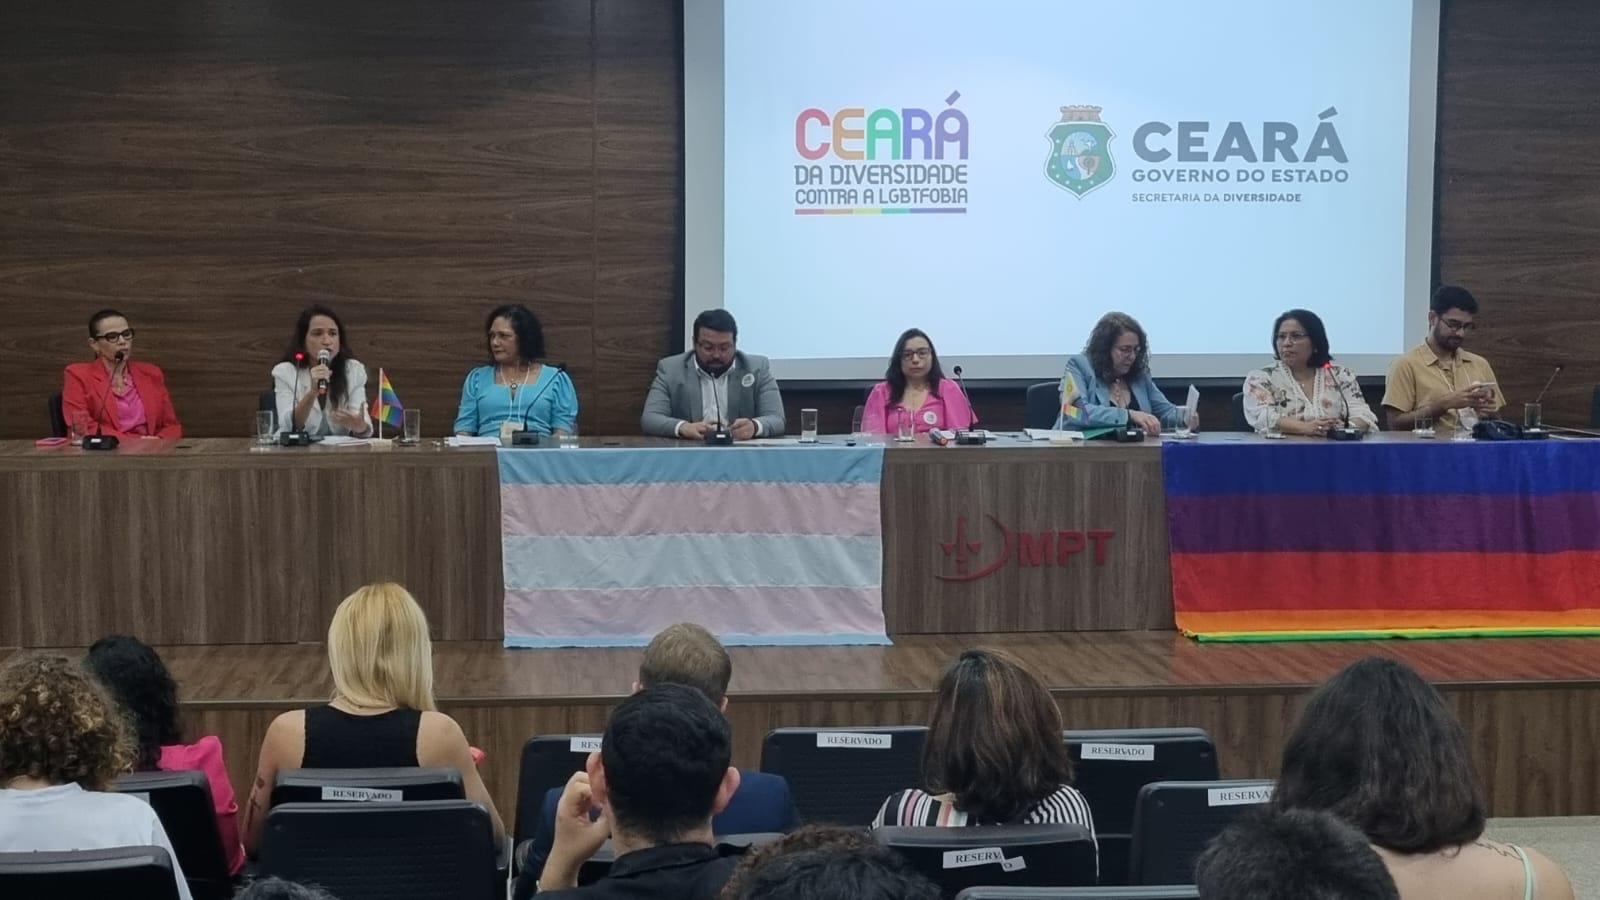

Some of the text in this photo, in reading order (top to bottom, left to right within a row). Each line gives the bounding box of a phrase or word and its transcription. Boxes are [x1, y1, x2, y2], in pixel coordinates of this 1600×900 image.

[795, 90, 969, 160] CEARÁ
[1132, 106, 1349, 163] CEARÁ
[794, 164, 968, 185] DA DIVERSIDADE
[1132, 169, 1349, 183] GOVERNO DO ESTADO
[795, 188, 968, 204] CONTRA A LGBTFOBIA
[1132, 193, 1302, 202] SECRETARIA DA DIVERSIDADE
[1018, 530, 1115, 566] MPT
[827, 737, 882, 745] RESERVADO
[1091, 747, 1145, 756] RESERVADO
[333, 790, 393, 800] RESERVADO
